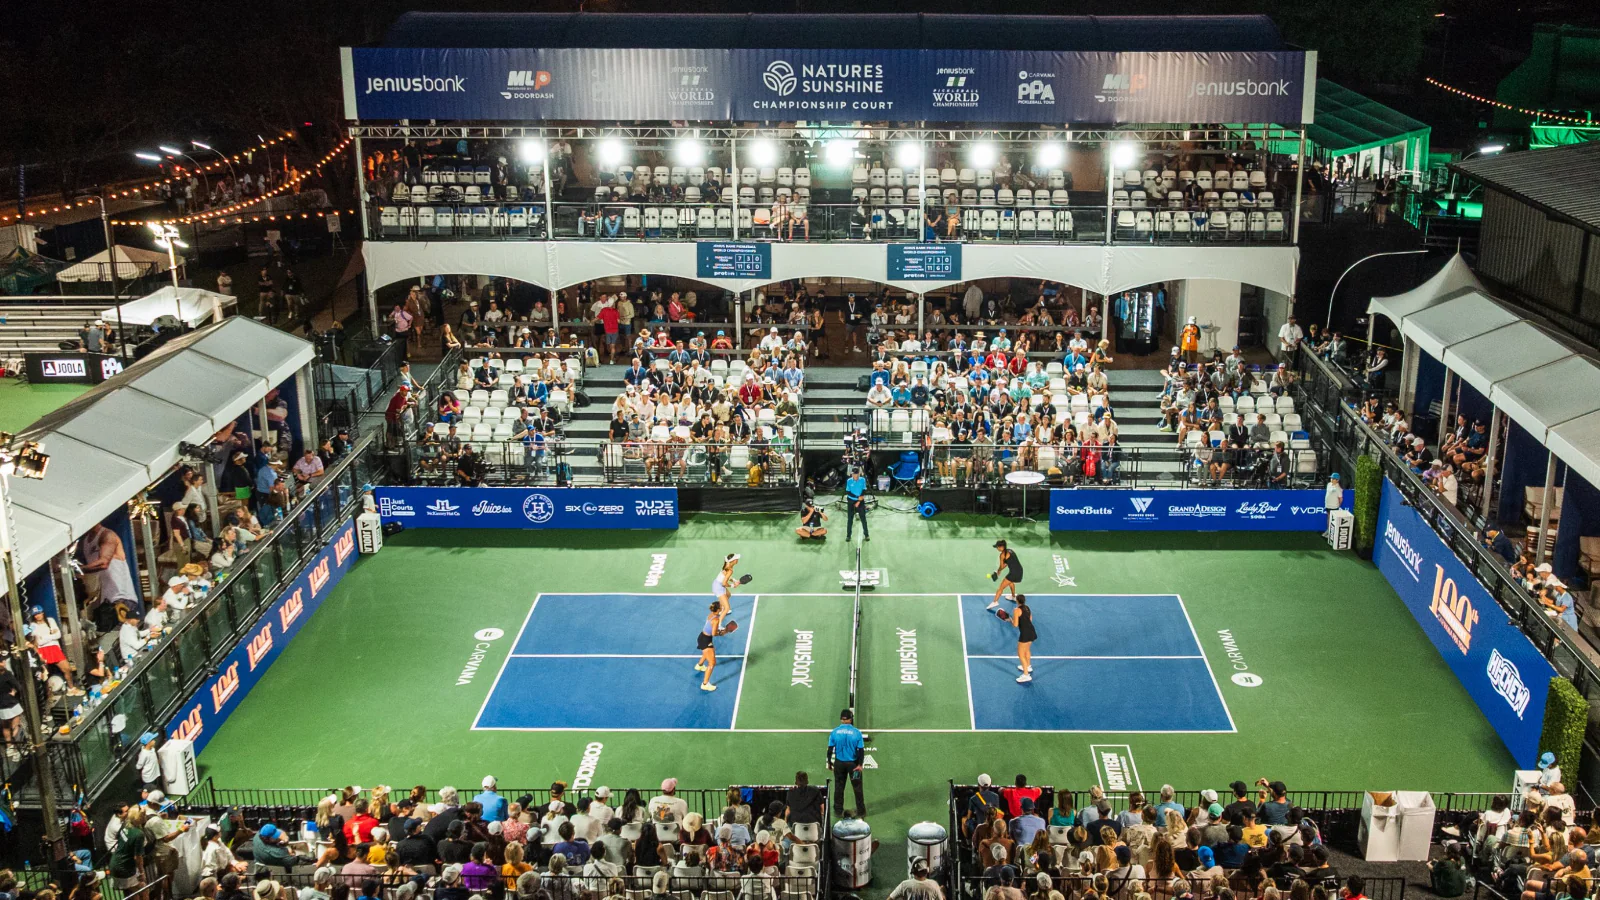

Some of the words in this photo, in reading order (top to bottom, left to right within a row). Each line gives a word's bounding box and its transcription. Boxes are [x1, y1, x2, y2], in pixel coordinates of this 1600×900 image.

[507, 70, 551, 90] MLP
[802, 64, 883, 78] NATURES
[936, 67, 975, 75] jeniusbank
[365, 75, 466, 94] jeniusbank
[802, 81, 883, 93] SUNSHINE
[1018, 80, 1055, 100] PPA
[1187, 79, 1289, 98] jeniusbank
[668, 91, 714, 101] WORLD
[753, 100, 847, 109] CHAMPIONSHIP
[852, 101, 894, 110] COURT
[932, 92, 980, 102] WORLD
[58, 362, 84, 373] JOOLA
[474, 500, 502, 516] Juice
[635, 500, 674, 508] DUDE
[1056, 505, 1113, 515] ScoreButts
[1236, 502, 1258, 514] Lady
[1257, 502, 1281, 514] Bird
[362, 531, 373, 552] JOOLA
[1338, 527, 1348, 549] JOOLA
[1385, 520, 1423, 574] jeniusbank
[1052, 554, 1065, 573] SELECT
[791, 629, 814, 687] jeniusbank
[896, 628, 922, 686] jeniusbank
[1217, 629, 1248, 671] CARVANA
[455, 642, 490, 686] CARVANA
[1488, 649, 1530, 717] HI-CHEW
[185, 761, 197, 791] JOOLA
[1101, 752, 1127, 791] ACRYTECH
